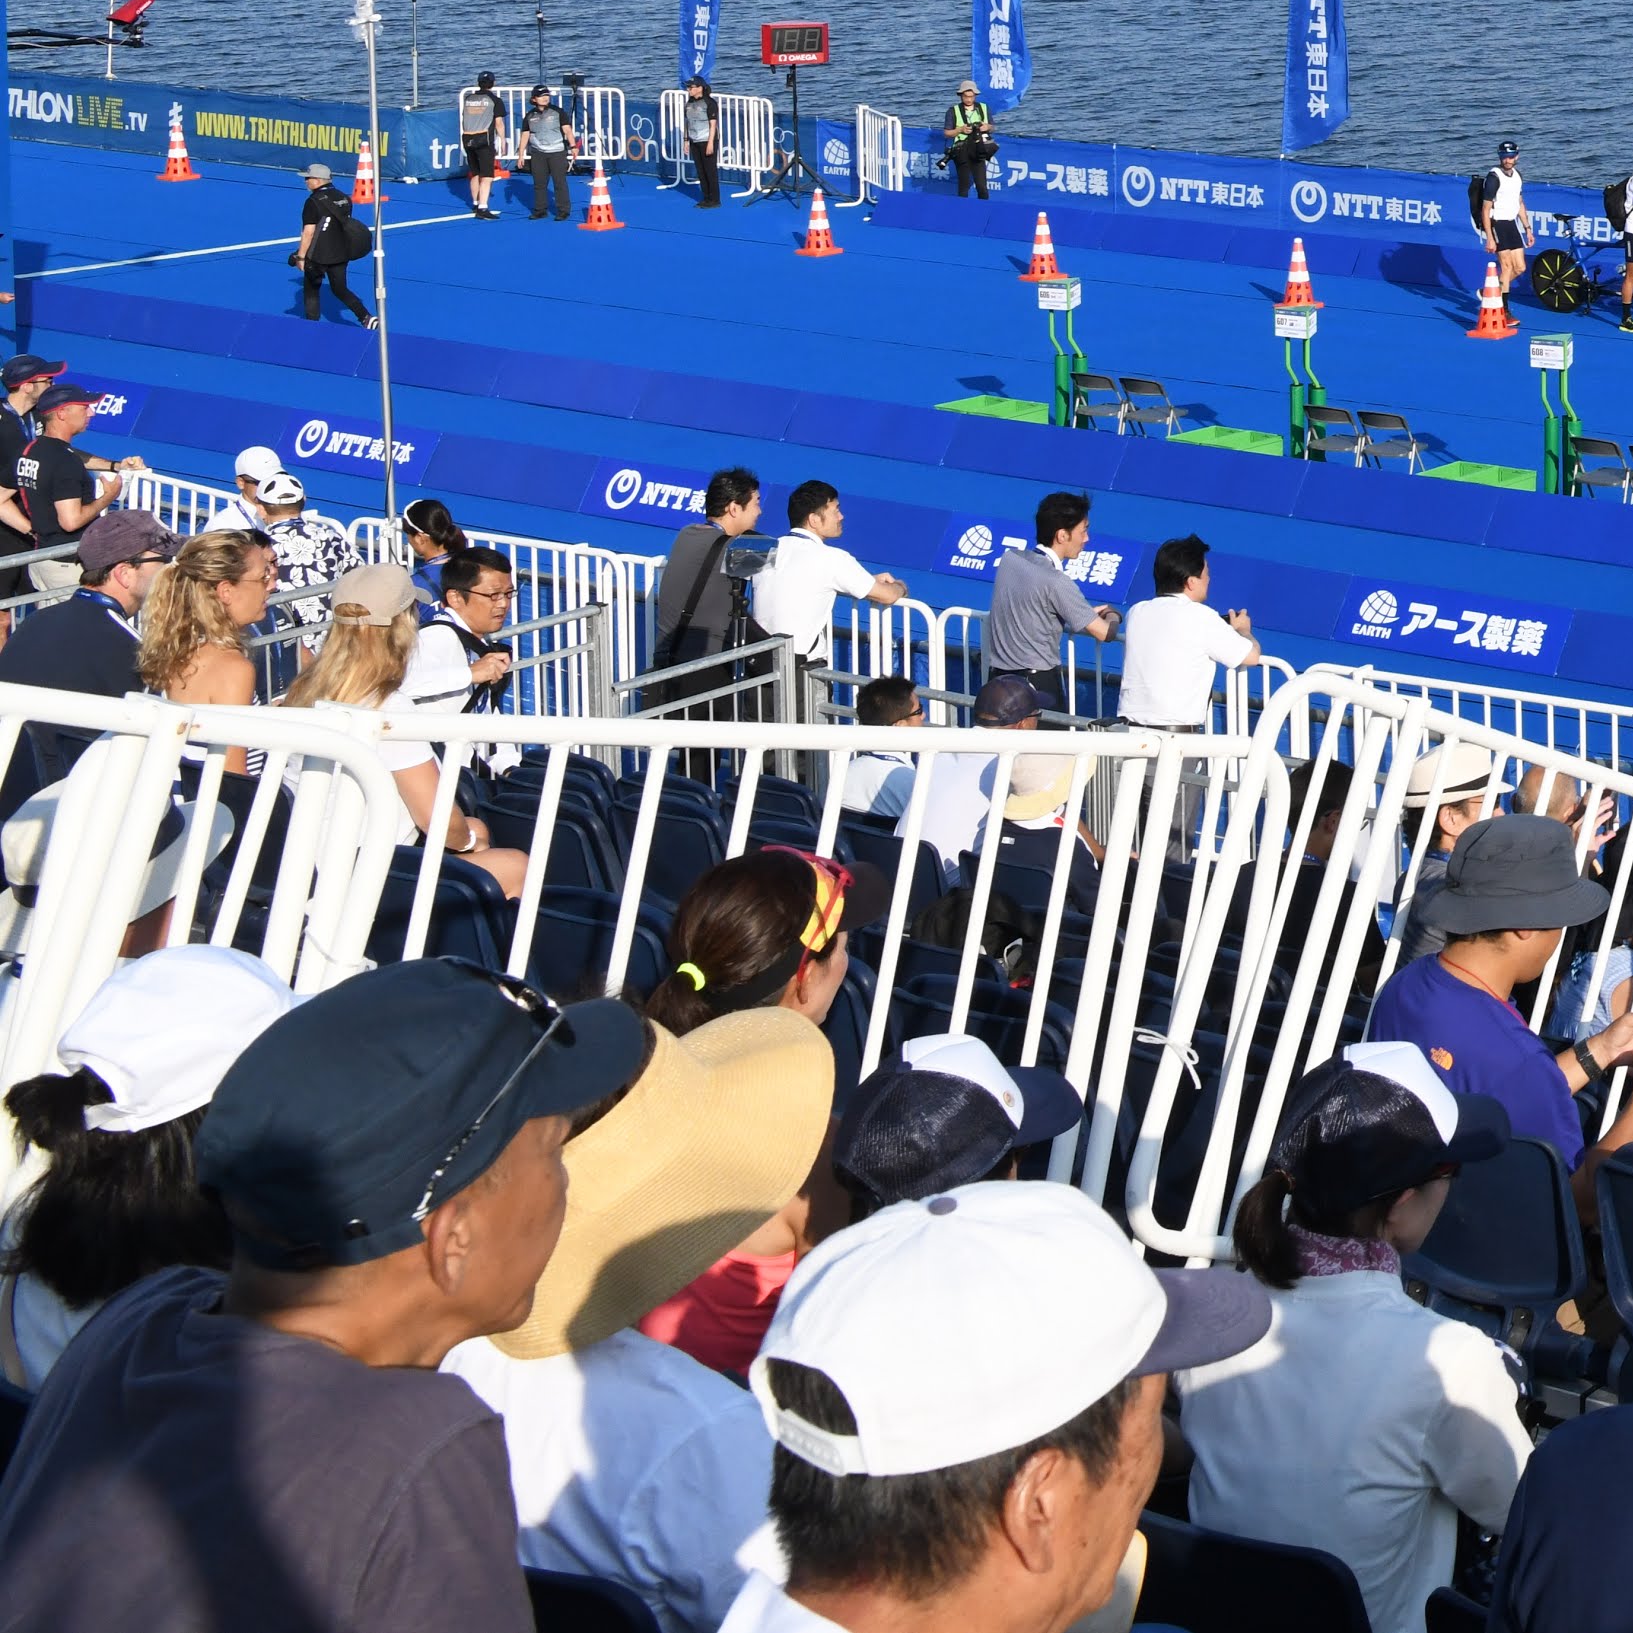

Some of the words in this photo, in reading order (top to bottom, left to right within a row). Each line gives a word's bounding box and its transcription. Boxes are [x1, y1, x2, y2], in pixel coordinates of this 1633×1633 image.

[788, 53, 818, 62] OMEGA
[196, 111, 389, 157] WWW.TRIATHLONLIVEV
[823, 165, 850, 176] EARTH
[1007, 160, 1109, 197] アース製薬
[1160, 176, 1265, 209] NTT東日本
[1332, 191, 1442, 226] NTT東日本
[1531, 347, 1544, 356] 608
[17, 457, 39, 480] GBR
[950, 555, 987, 571] EARTH
[1352, 622, 1393, 640] EARTH
[1400, 601, 1547, 657] アース製薬
